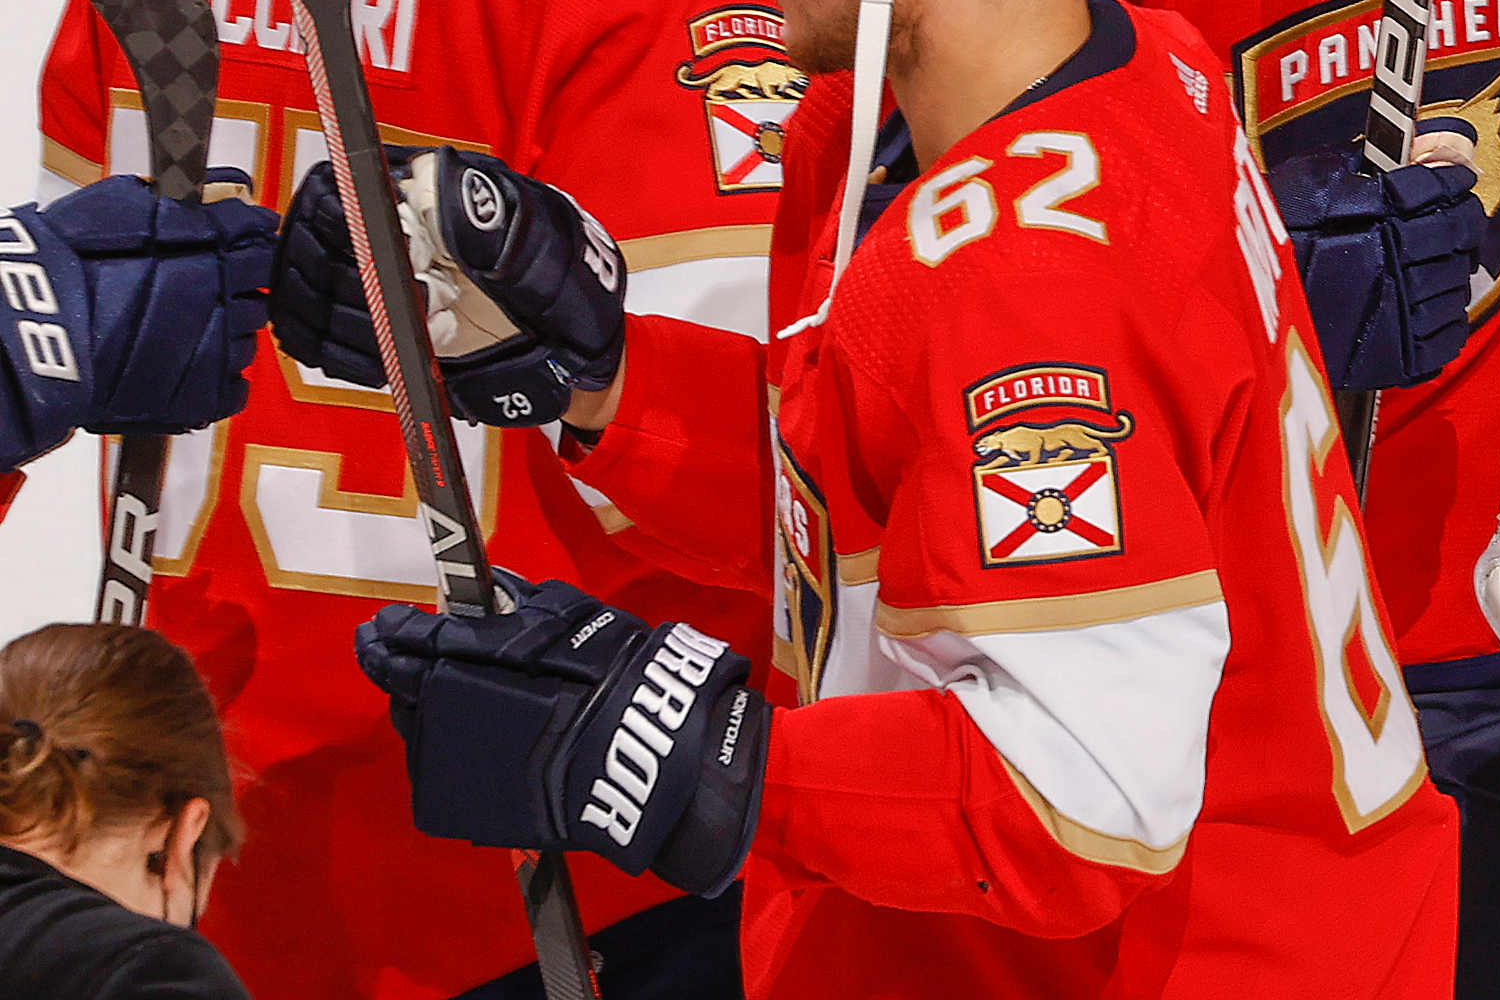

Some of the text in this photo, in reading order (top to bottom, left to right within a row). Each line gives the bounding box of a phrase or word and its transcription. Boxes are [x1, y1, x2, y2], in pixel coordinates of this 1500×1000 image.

[907, 130, 1111, 268] 62
[493, 391, 533, 420] 62
[983, 375, 1091, 410] FLORIDA
